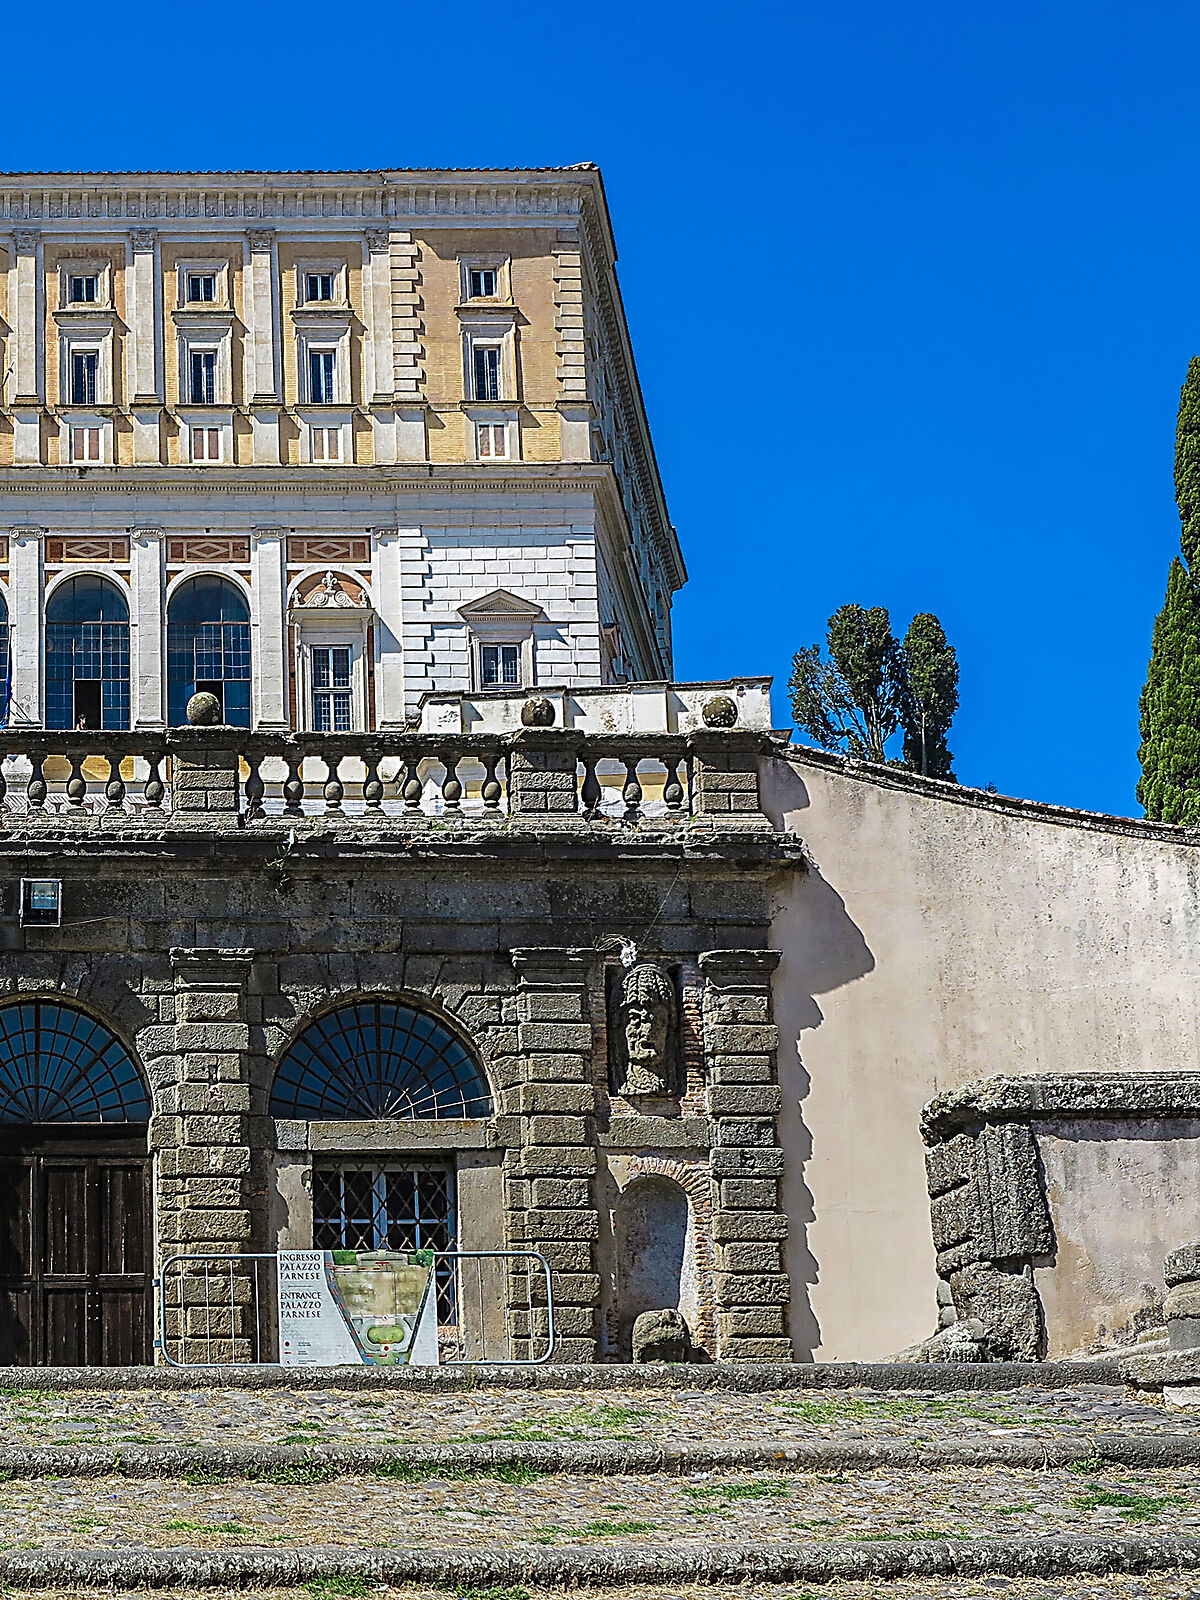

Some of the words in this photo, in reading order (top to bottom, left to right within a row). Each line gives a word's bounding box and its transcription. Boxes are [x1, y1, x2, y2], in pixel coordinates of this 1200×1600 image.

[280, 1253, 321, 1261] INGRESSO
[280, 1301, 322, 1309] PALAZZO
[281, 1310, 321, 1318] FARNESE
